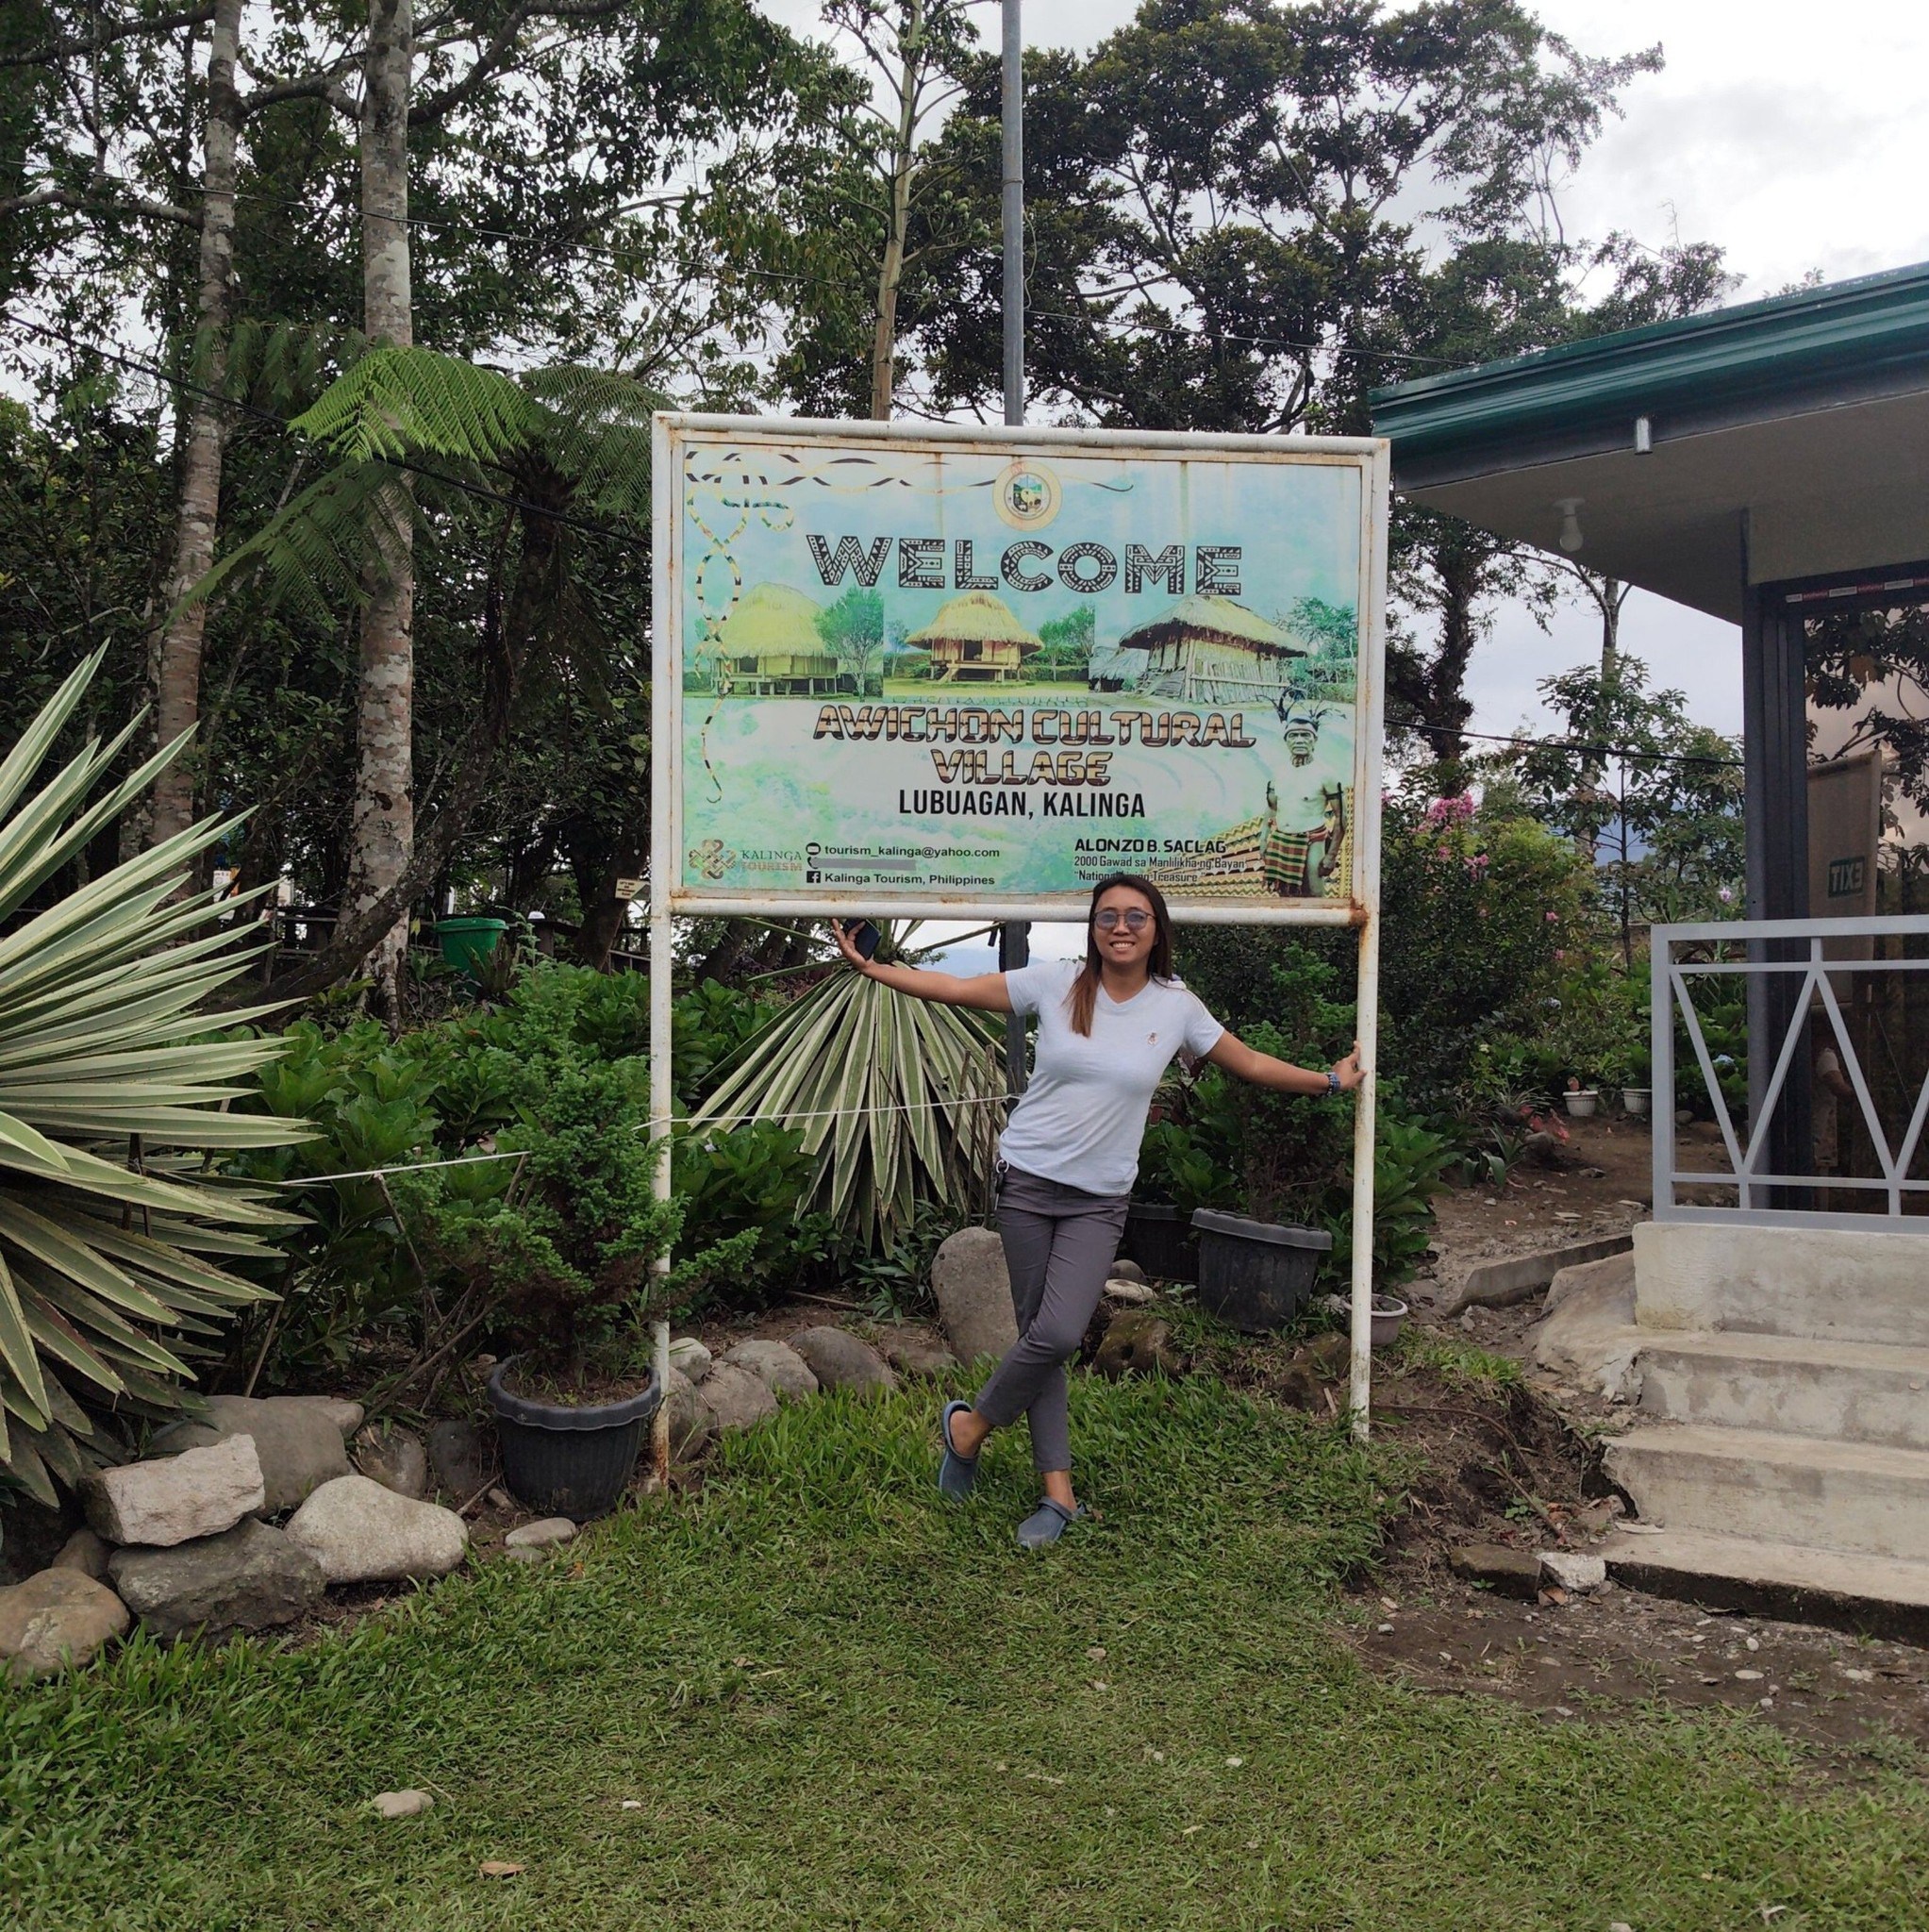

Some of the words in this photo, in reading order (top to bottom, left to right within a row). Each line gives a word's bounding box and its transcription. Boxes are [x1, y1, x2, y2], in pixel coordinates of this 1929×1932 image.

[806, 535, 1242, 594] WELCOME
[813, 705, 1023, 743] AWICHON
[1032, 709, 1256, 747] CULTURAL
[930, 749, 1113, 786] VILLAGE
[899, 789, 1034, 820] LUBUAGAN,
[1043, 791, 1145, 818] KALINGA
[824, 845, 1000, 858] tourism_kalinga@yahoo.com
[1074, 839, 1144, 853] ALONZO
[1147, 840, 1160, 853] B.
[1163, 840, 1226, 854] SACLAG
[740, 850, 802, 861] KALINGA
[741, 861, 803, 872] TOURISM
[1074, 856, 1098, 867] 2000
[1099, 856, 1132, 867] Gawad
[1149, 857, 1198, 868] Manlilikha
[1214, 858, 1245, 871] Bayan
[824, 873, 871, 885] Kalinga
[873, 874, 925, 885] Tourism,
[929, 874, 995, 887] Philippines
